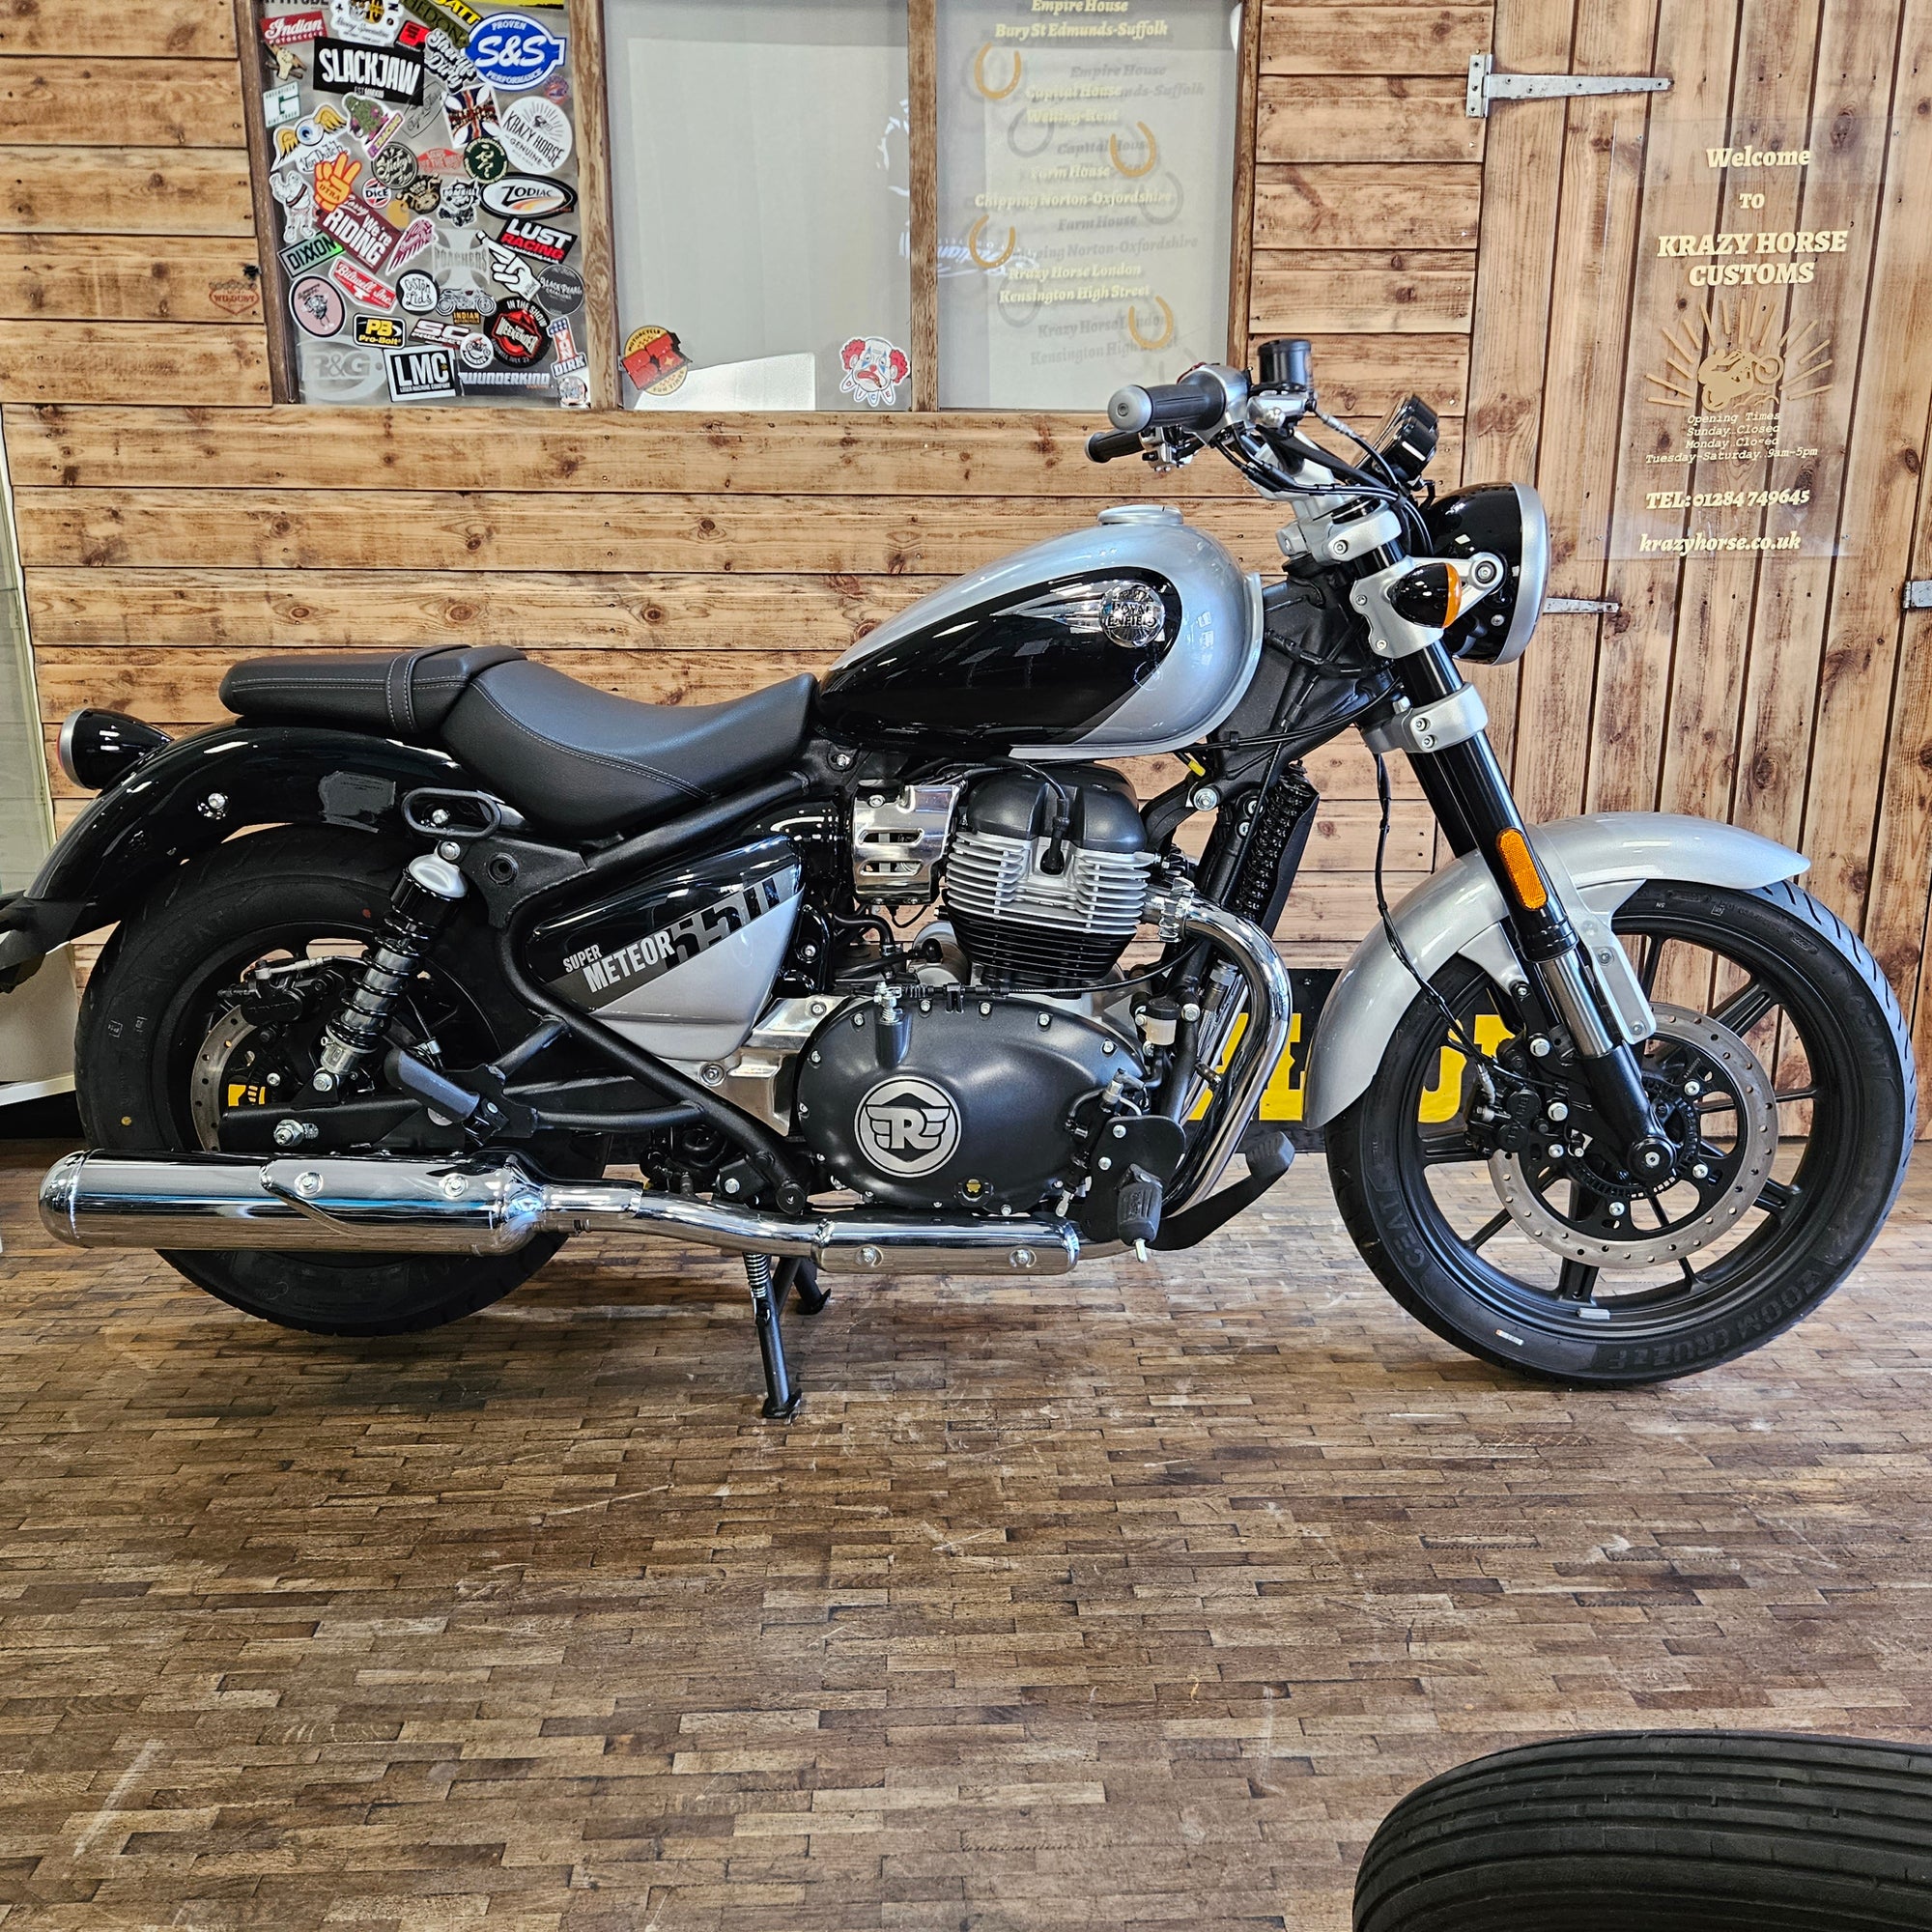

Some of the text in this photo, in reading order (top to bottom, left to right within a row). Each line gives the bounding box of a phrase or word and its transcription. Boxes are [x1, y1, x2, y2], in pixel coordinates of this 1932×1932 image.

[1031, 0, 1128, 15] Empire House
[265, 17, 324, 40] Indian
[492, 20, 526, 31] PROVEN
[995, 19, 1168, 41] Bury St Edmunds-Suffolk
[474, 35, 547, 67] S&S
[319, 48, 421, 95] SLACKJAW
[502, 110, 536, 142] KRAZY
[532, 135, 564, 167] HORSE
[1706, 146, 1811, 168] Welcome
[501, 185, 553, 207] ZODIAC
[1739, 193, 1765, 210] TO
[323, 208, 386, 267] RIDING
[505, 218, 572, 249] LUST
[1657, 230, 1849, 258] KRAZY HORSE
[286, 237, 337, 270] DIXXON
[500, 233, 565, 261] RACING
[1689, 263, 1815, 287] CUSTOMS
[999, 288, 1074, 305] Kensington
[1077, 287, 1110, 302] High
[453, 311, 480, 320] INDIAN
[506, 299, 516, 310] IN
[529, 304, 548, 327] SHOW
[365, 319, 393, 336] PB
[413, 320, 470, 341] SC
[304, 351, 371, 378] R&G
[394, 352, 449, 385] LMC
[554, 355, 585, 376] DIRK
[458, 372, 551, 385] WUNDERKIND
[1687, 412, 1780, 426] Opening Times
[1747, 489, 1810, 505] 749645
[1639, 532, 1801, 557] krazyhorse.co.uk
[562, 944, 603, 974] SUPER
[582, 930, 676, 994] METEOR
